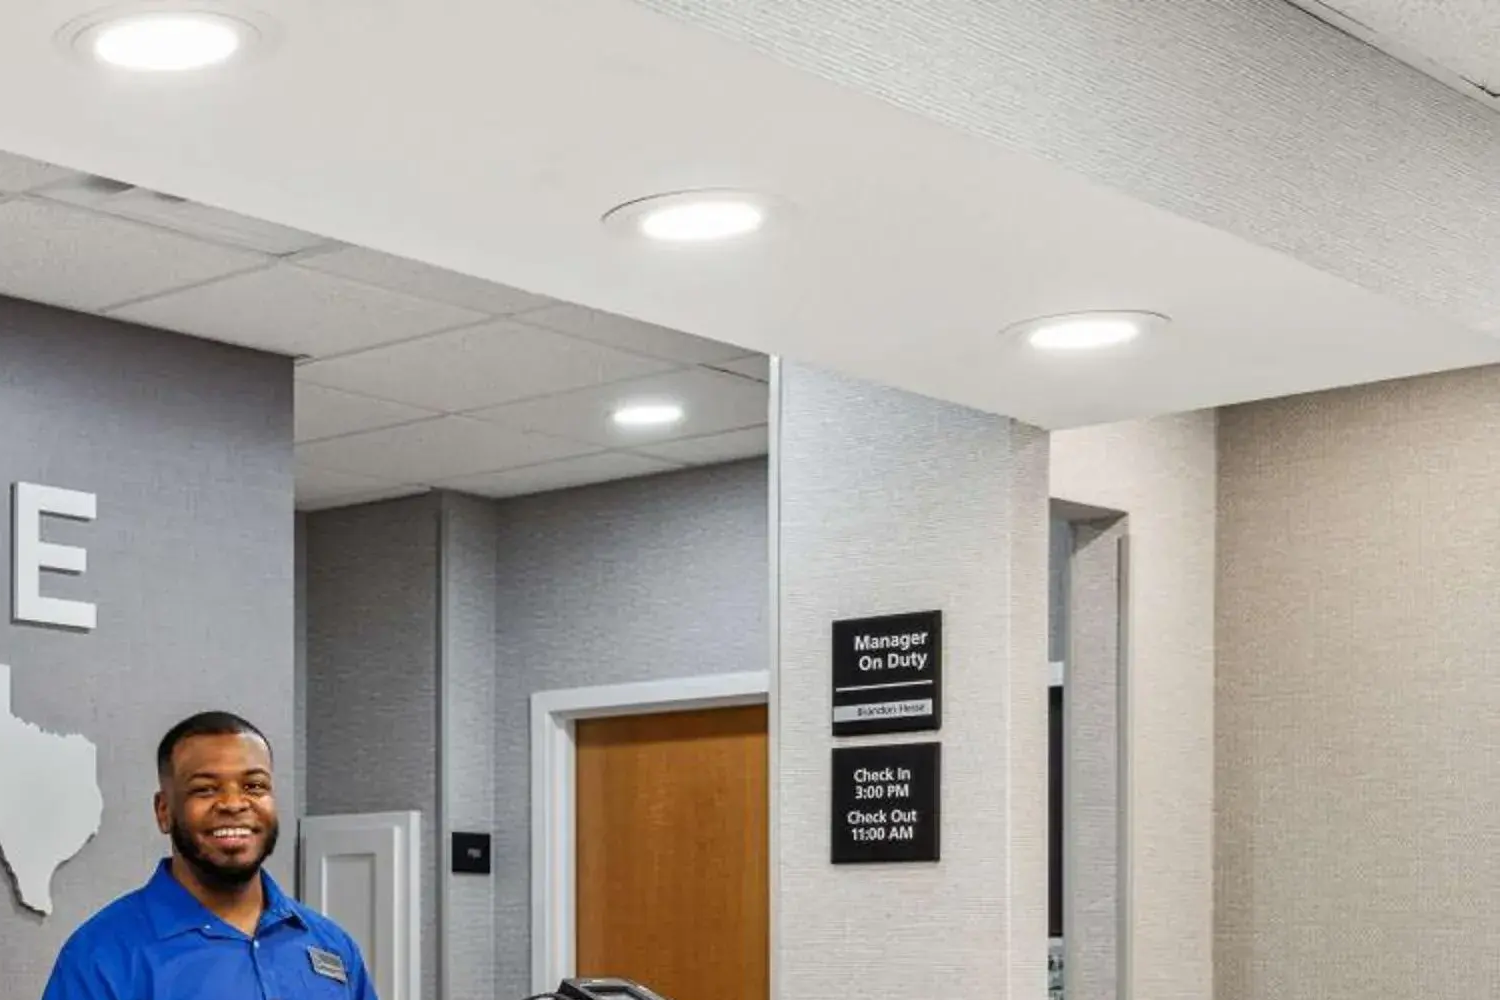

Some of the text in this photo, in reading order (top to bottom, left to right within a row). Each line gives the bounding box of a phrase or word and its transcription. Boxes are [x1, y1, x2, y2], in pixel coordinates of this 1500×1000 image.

[854, 631, 929, 651] Manager
[859, 651, 928, 671] On Duty
[853, 767, 911, 783] Check In
[855, 783, 909, 799] 3:00 PM
[847, 808, 917, 825] Check Out
[851, 825, 913, 841] 11:00 AM
